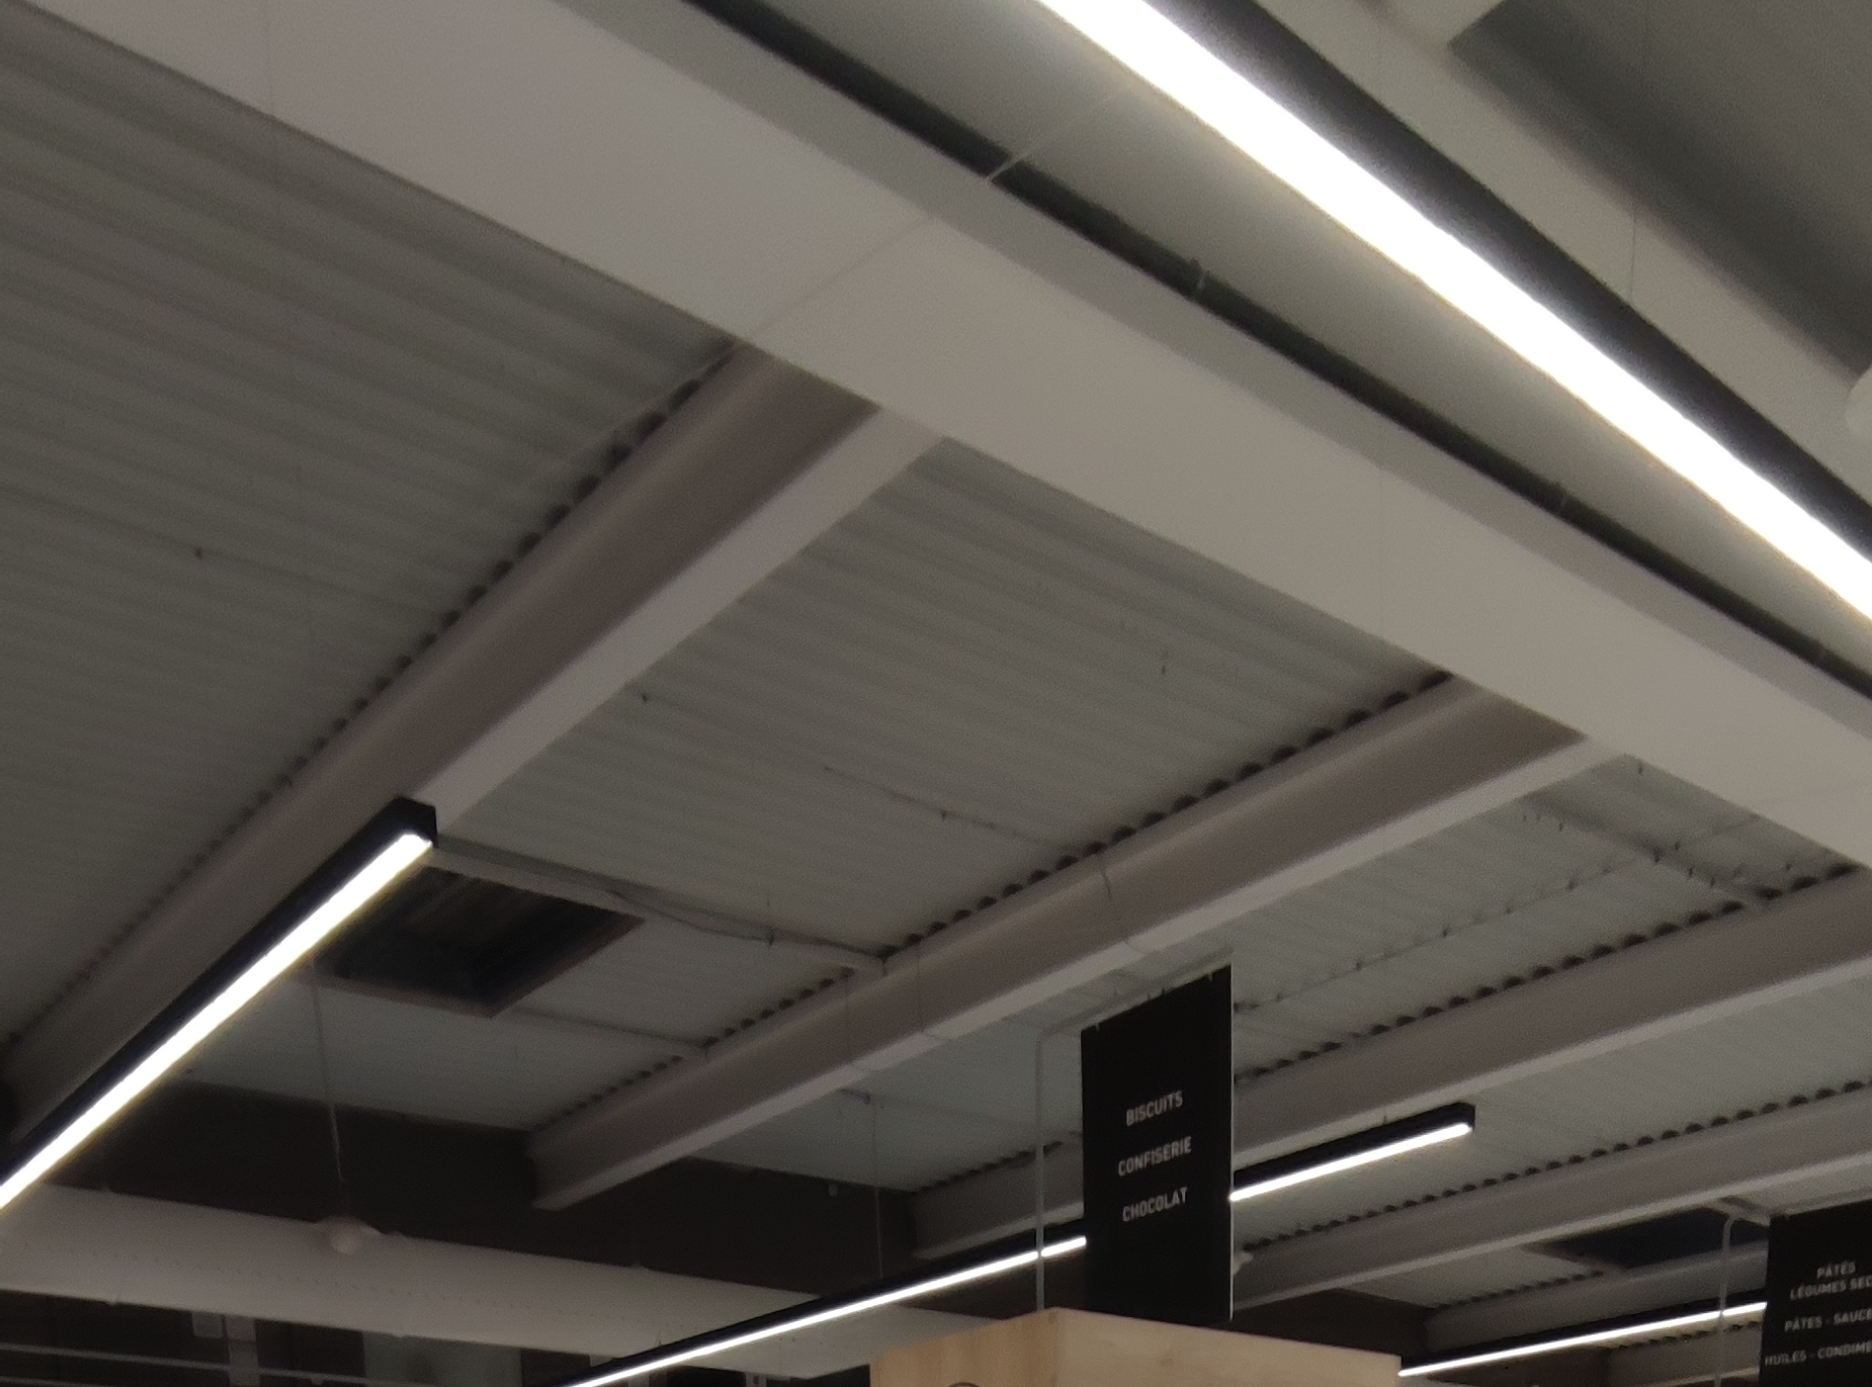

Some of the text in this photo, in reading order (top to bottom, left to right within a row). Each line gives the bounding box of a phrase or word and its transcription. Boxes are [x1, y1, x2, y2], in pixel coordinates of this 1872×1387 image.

[1126, 1090, 1183, 1126] BISCUITS
[1118, 1135, 1192, 1176] CONFISERIE
[1122, 1186, 1188, 1221] CHOCOLAT
[1764, 1350, 1807, 1366] HUILES
